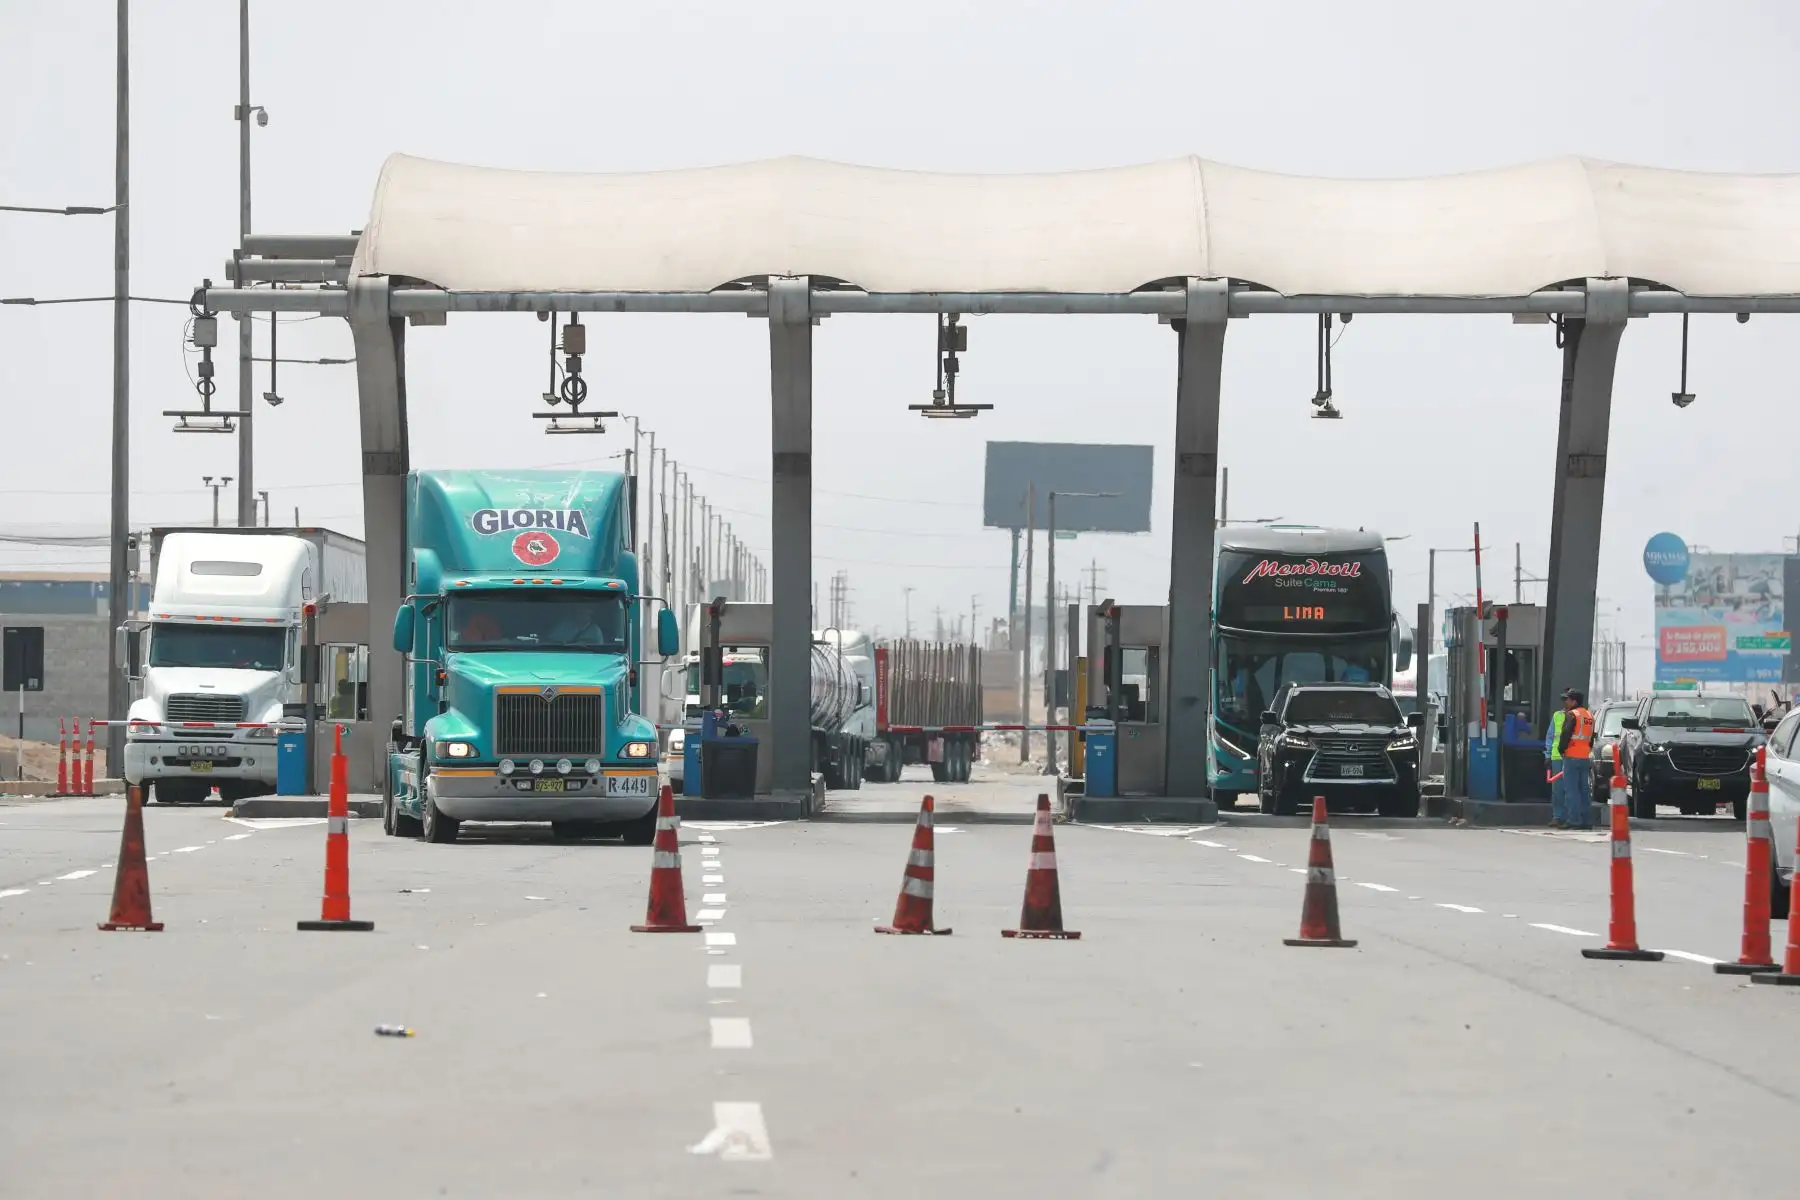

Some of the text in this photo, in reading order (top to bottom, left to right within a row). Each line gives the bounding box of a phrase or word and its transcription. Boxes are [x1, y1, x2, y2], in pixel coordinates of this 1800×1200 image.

[472, 509, 590, 539] GLORIA
[1243, 559, 1361, 584] Mendivil
[1284, 606, 1324, 620] LIMA
